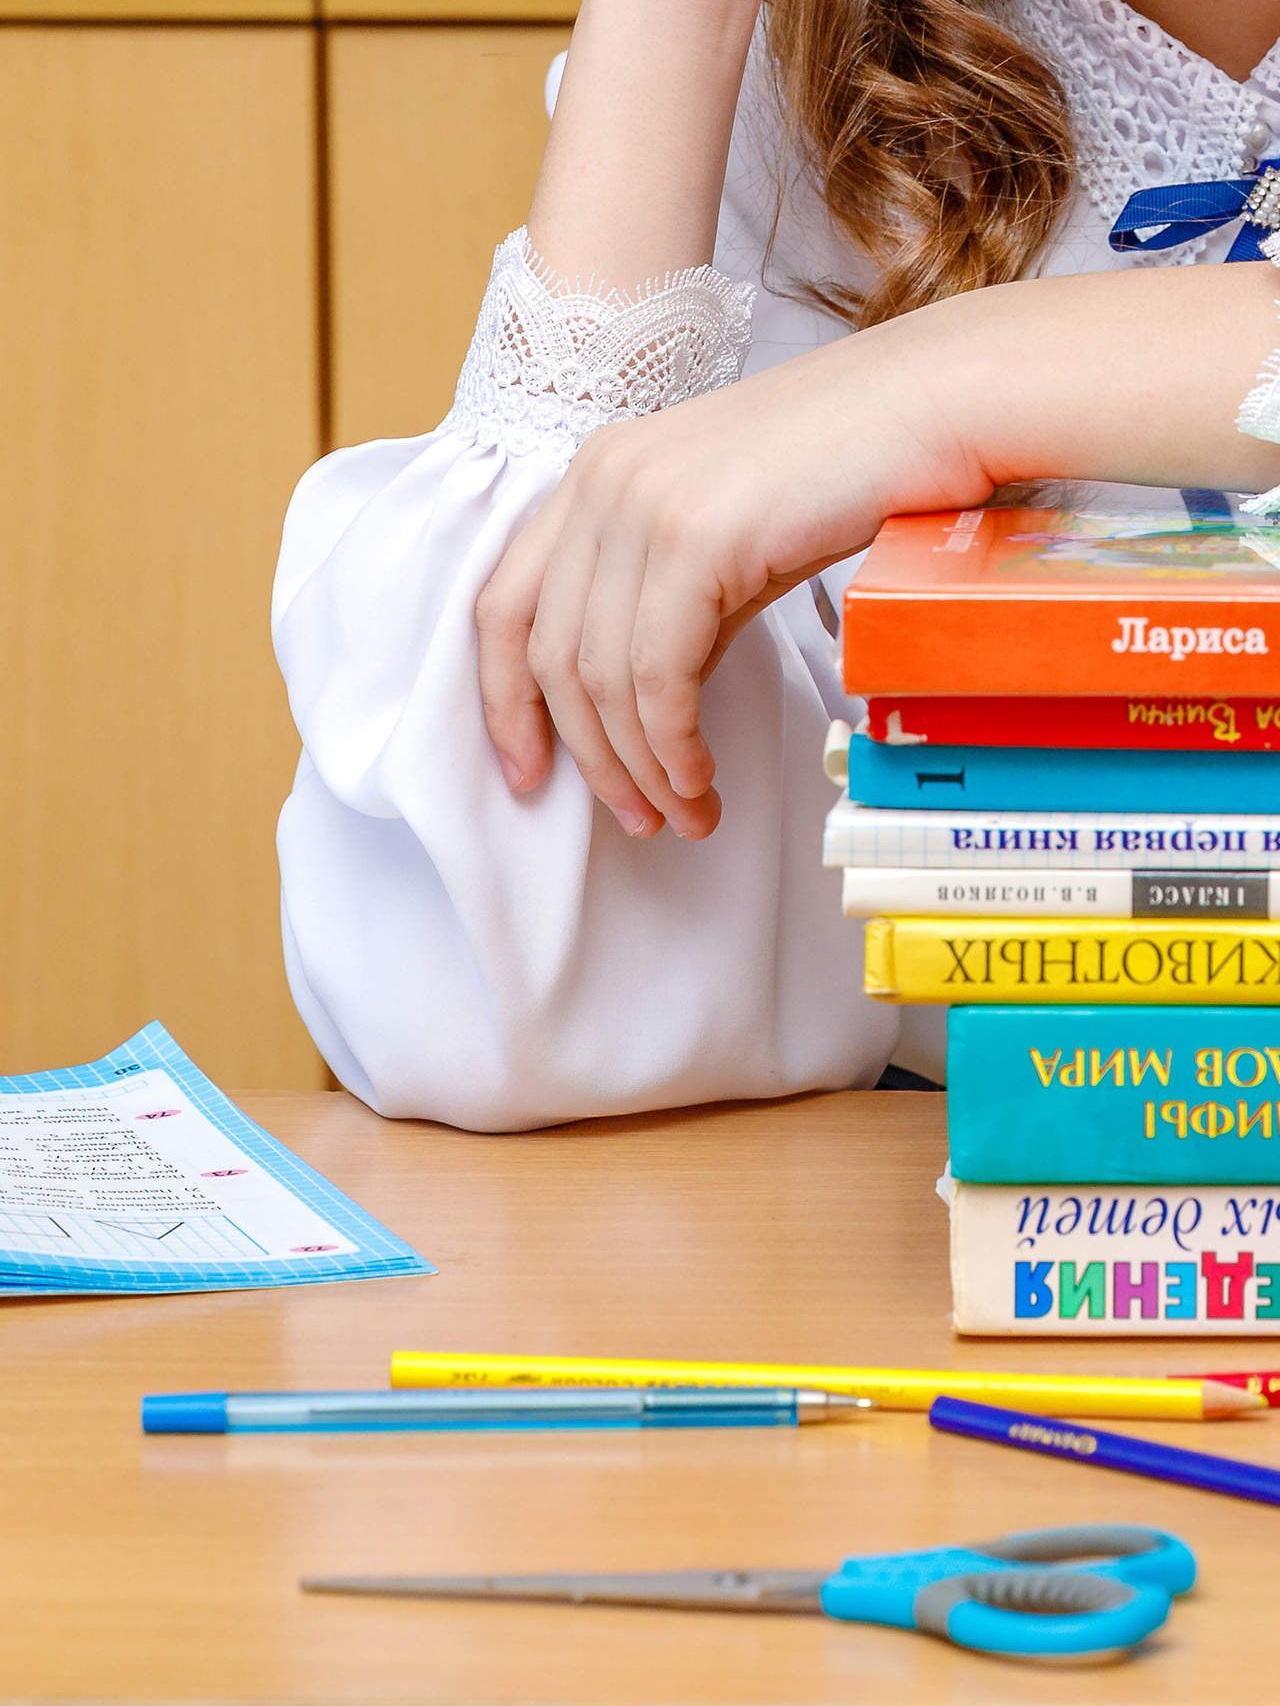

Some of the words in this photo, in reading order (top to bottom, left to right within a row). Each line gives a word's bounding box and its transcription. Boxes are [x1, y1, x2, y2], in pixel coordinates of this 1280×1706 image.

[1112, 617, 1268, 661] Лариса
[951, 827, 1081, 854] книга
[1093, 829, 1248, 862] первая
[1149, 885, 1231, 908] КЛАСС
[1029, 1047, 1172, 1087] МИРА
[1014, 1196, 1201, 1251] детей
